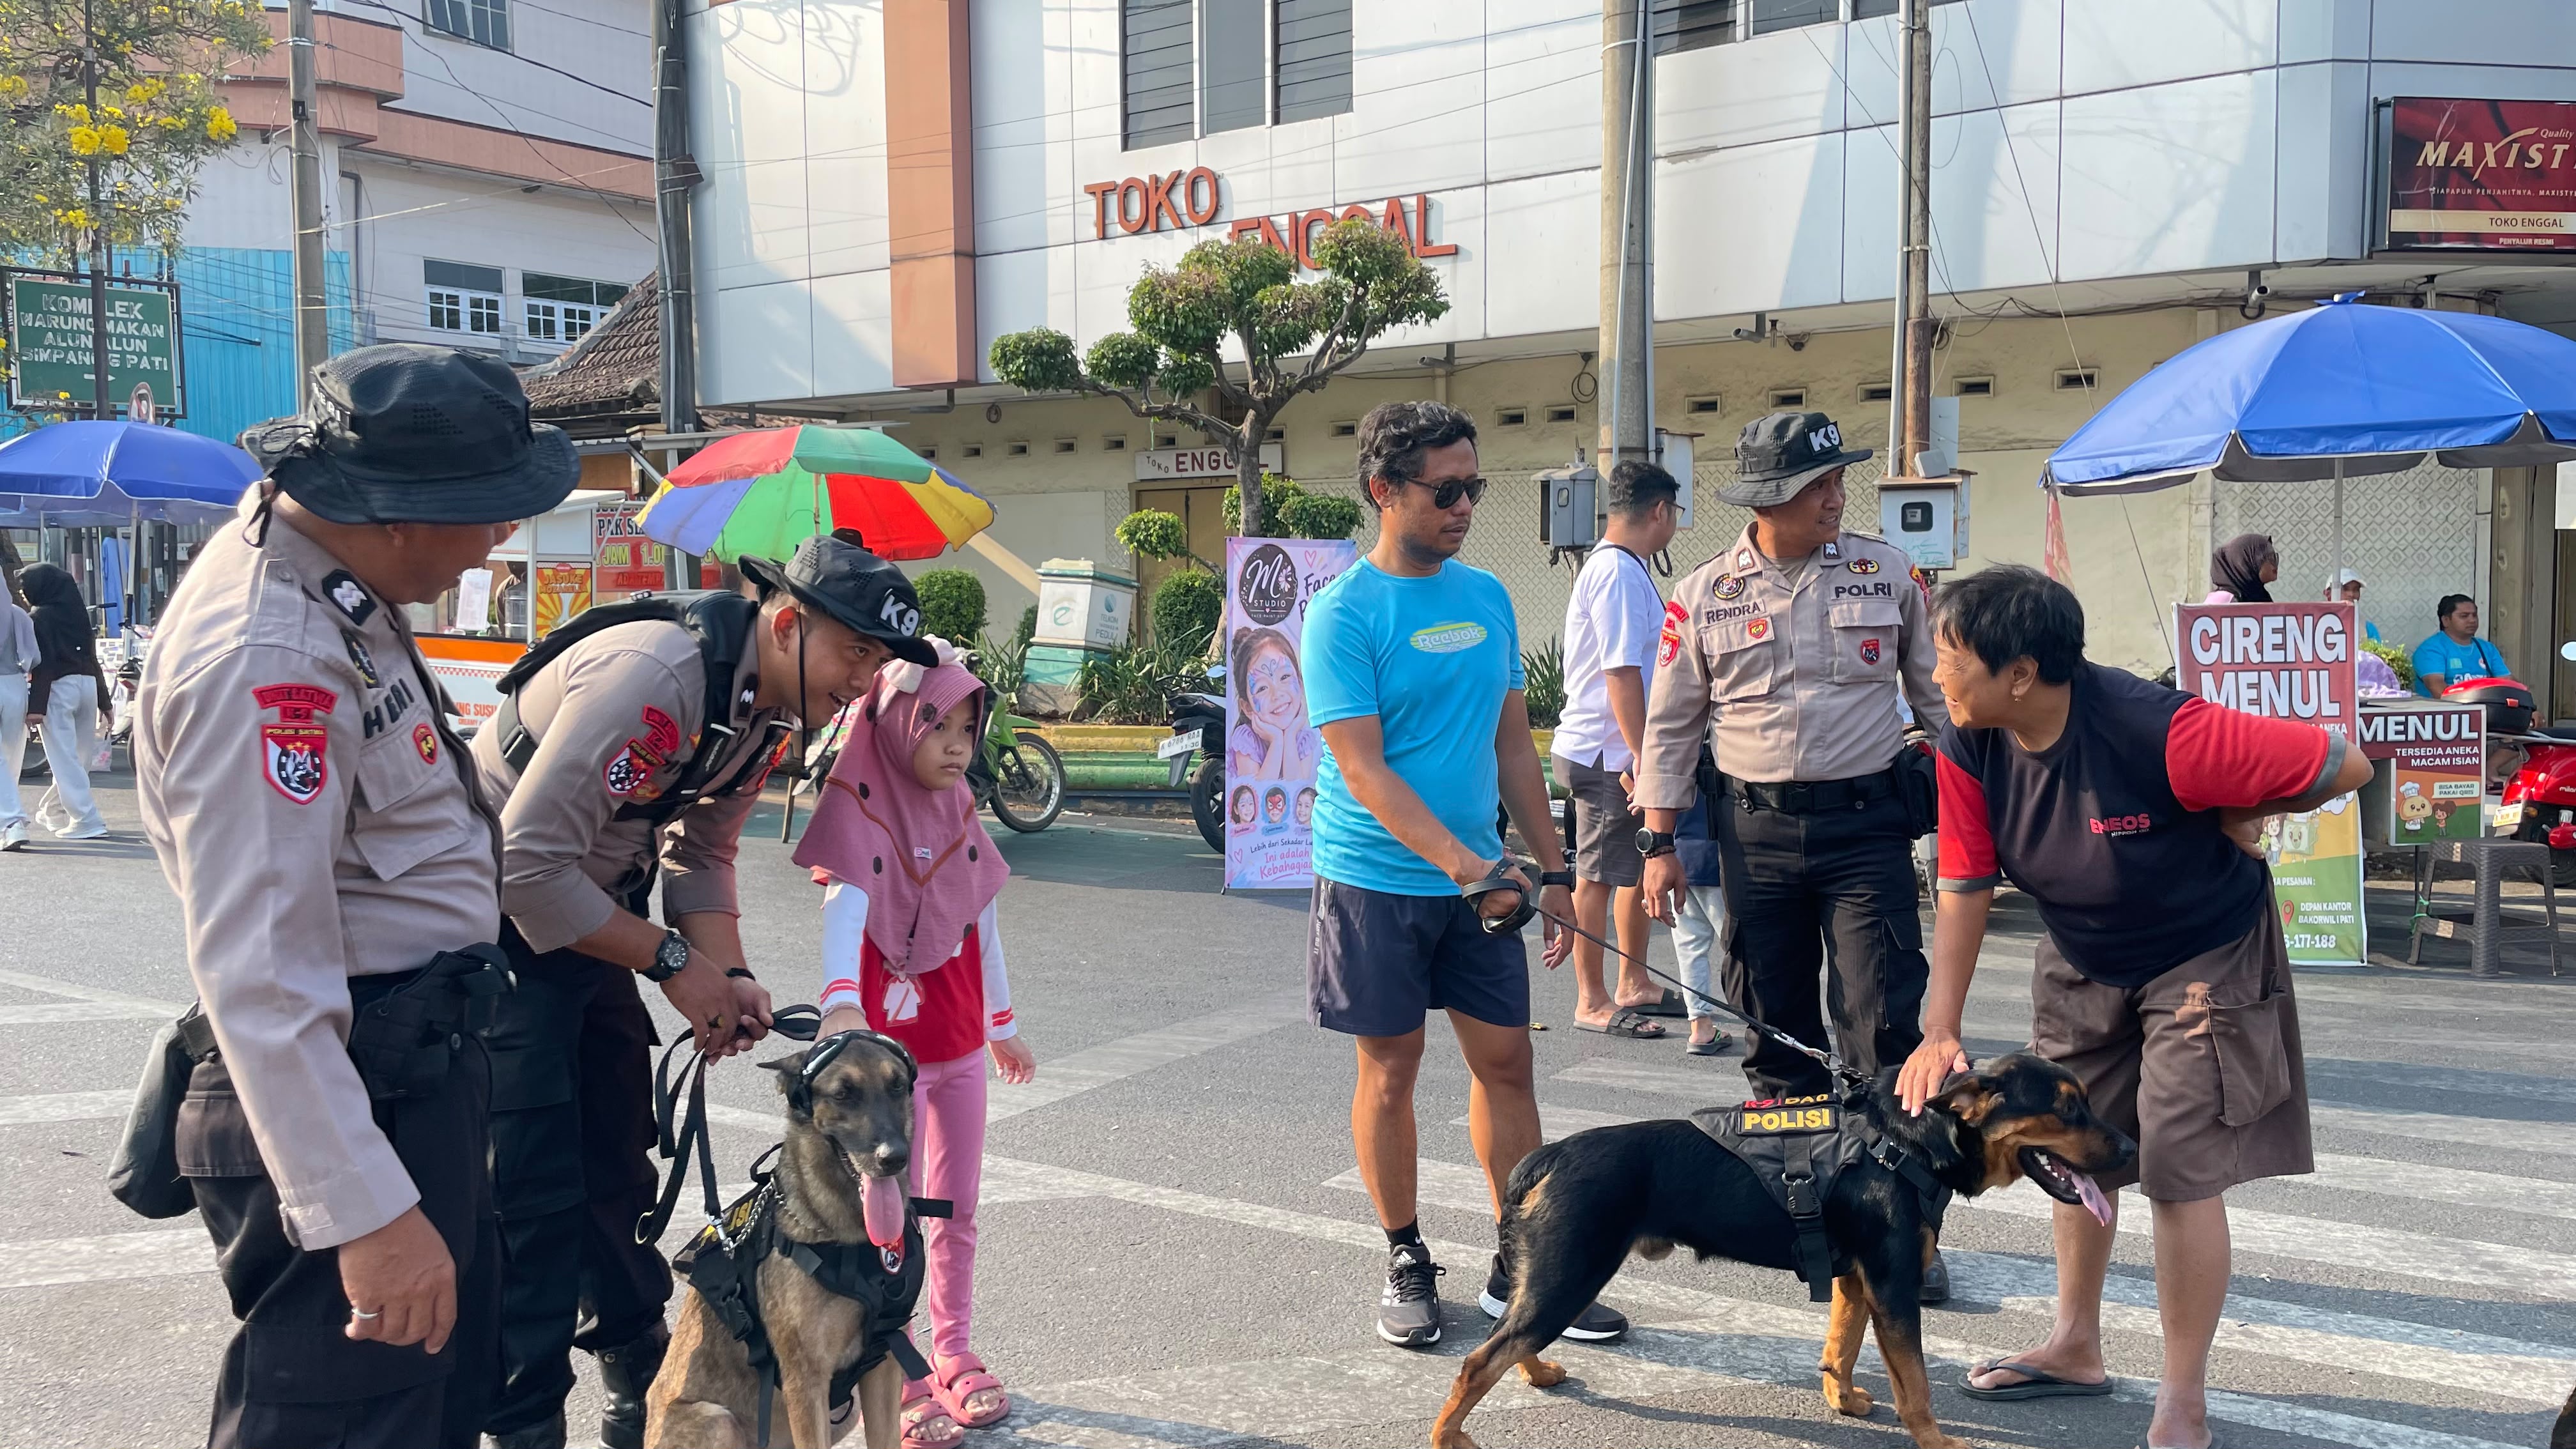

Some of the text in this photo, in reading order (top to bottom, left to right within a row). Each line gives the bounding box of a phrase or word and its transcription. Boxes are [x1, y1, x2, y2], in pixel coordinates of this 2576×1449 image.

[2540, 128, 2574, 140] Quality
[2416, 133, 2576, 176] MAXIST
[1084, 166, 1218, 240] TOKO
[2489, 217, 2564, 227] TOKO ENGGAL
[42, 294, 144, 319] KOMLEK
[126, 354, 168, 371] PATI
[1809, 422, 1841, 452] K9
[1146, 456, 1169, 473] TOKO
[603, 545, 630, 565] JAM
[544, 574, 583, 585] JASUKE
[1834, 582, 1892, 599] POLRI
[1254, 599, 1286, 608] STUDIO
[879, 595, 919, 637] K9
[1706, 601, 1761, 624] RENDRA
[1417, 626, 1482, 648] Reebok
[2190, 612, 2347, 666] CIRENG
[2200, 668, 2341, 718] MENUL
[2359, 713, 2479, 742] MENUL
[2396, 746, 2480, 756] TERSEDIA ANEKA
[2411, 756, 2479, 767] MACAM ISIAN
[1250, 842, 1267, 854] Lebih
[1268, 839, 1278, 848] dari
[1280, 838, 1304, 847] Sekadar
[1264, 847, 1310, 864] Ini adalah
[2301, 901, 2352, 911] DEPAN KANTOR
[2298, 916, 2336, 924] BAKORWIL
[2340, 915, 2354, 924] PATI
[1744, 1098, 1774, 1108] K-9
[1744, 1108, 1831, 1131] POLISI
